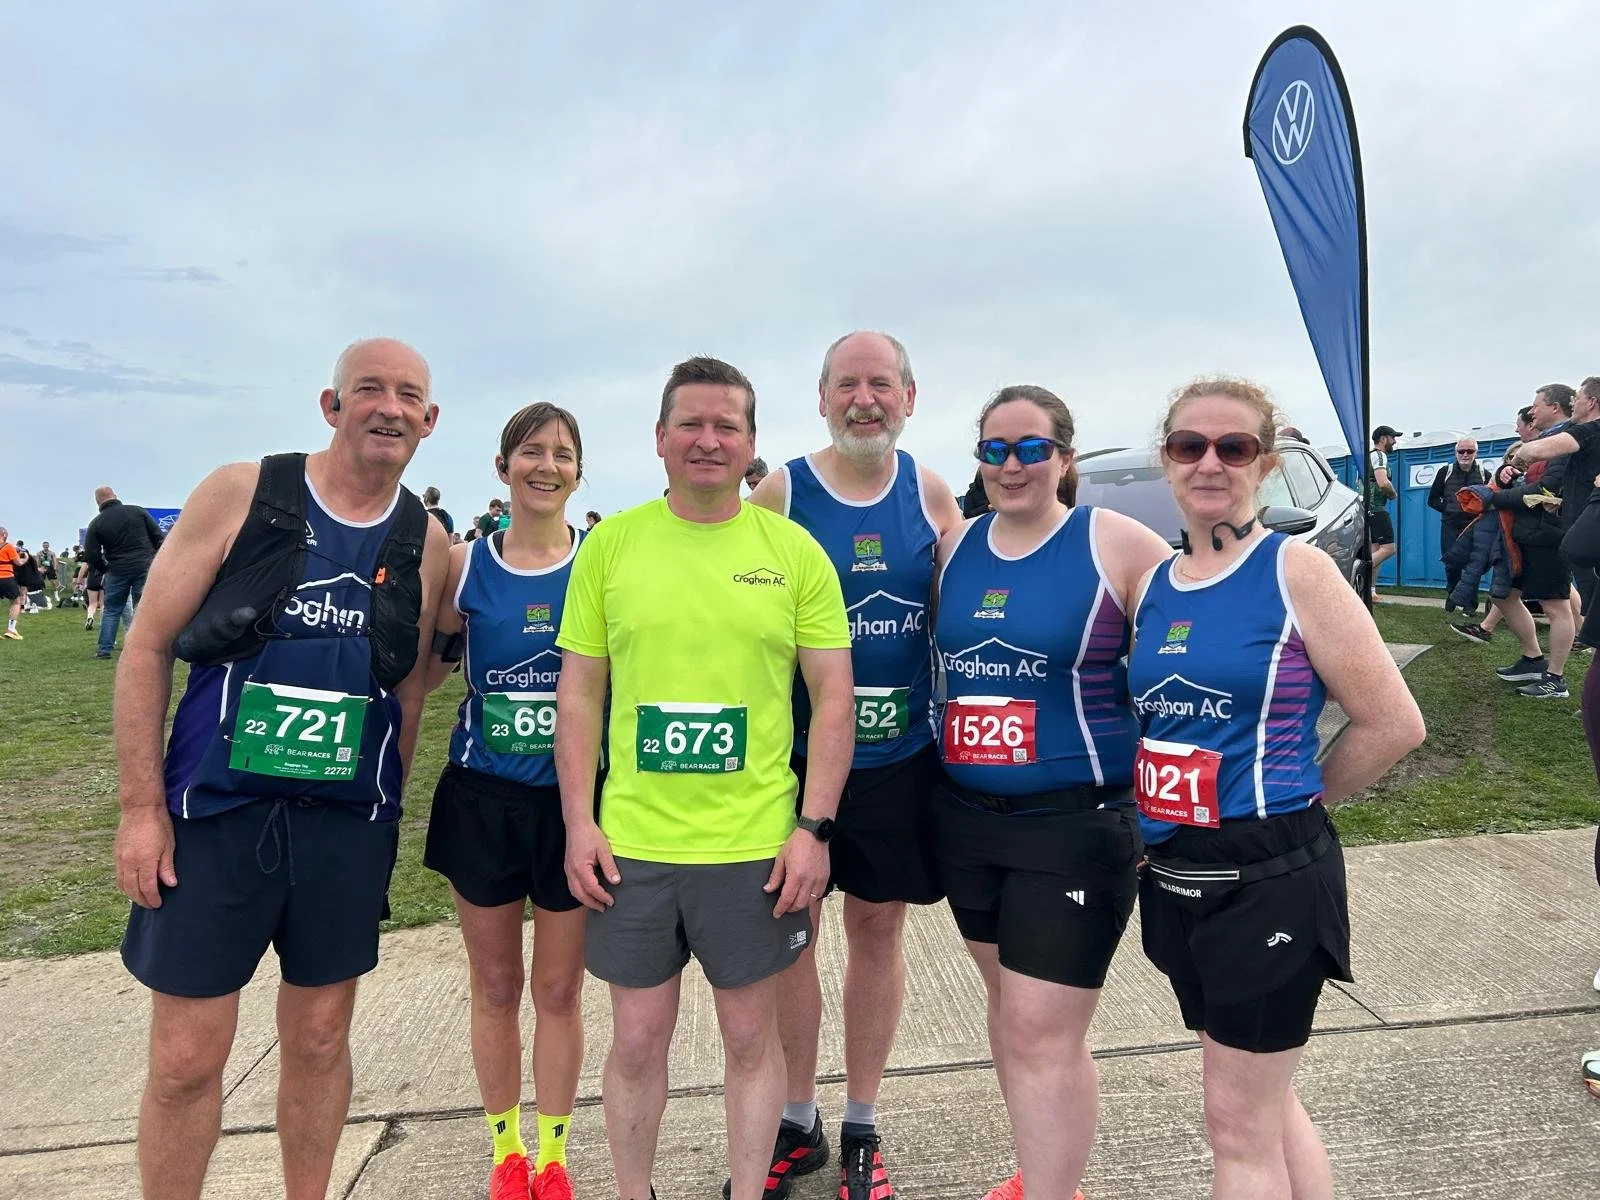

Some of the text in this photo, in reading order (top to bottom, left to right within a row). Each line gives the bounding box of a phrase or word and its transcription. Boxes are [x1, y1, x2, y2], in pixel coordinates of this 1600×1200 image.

[733, 574, 771, 585] Croghan
[773, 577, 786, 586] AC
[901, 610, 924, 633] AC
[943, 652, 1047, 679] Croghan AC
[491, 706, 557, 736] 23 69
[855, 701, 897, 728] 52
[1200, 698, 1232, 719] AC
[244, 704, 347, 743] 22 721
[951, 715, 1024, 747] 1526
[643, 721, 734, 755] 22 673
[287, 749, 307, 757] BEAR
[324, 767, 352, 775] 22721
[1137, 758, 1200, 804] 1021
[1166, 808, 1188, 818] RACES
